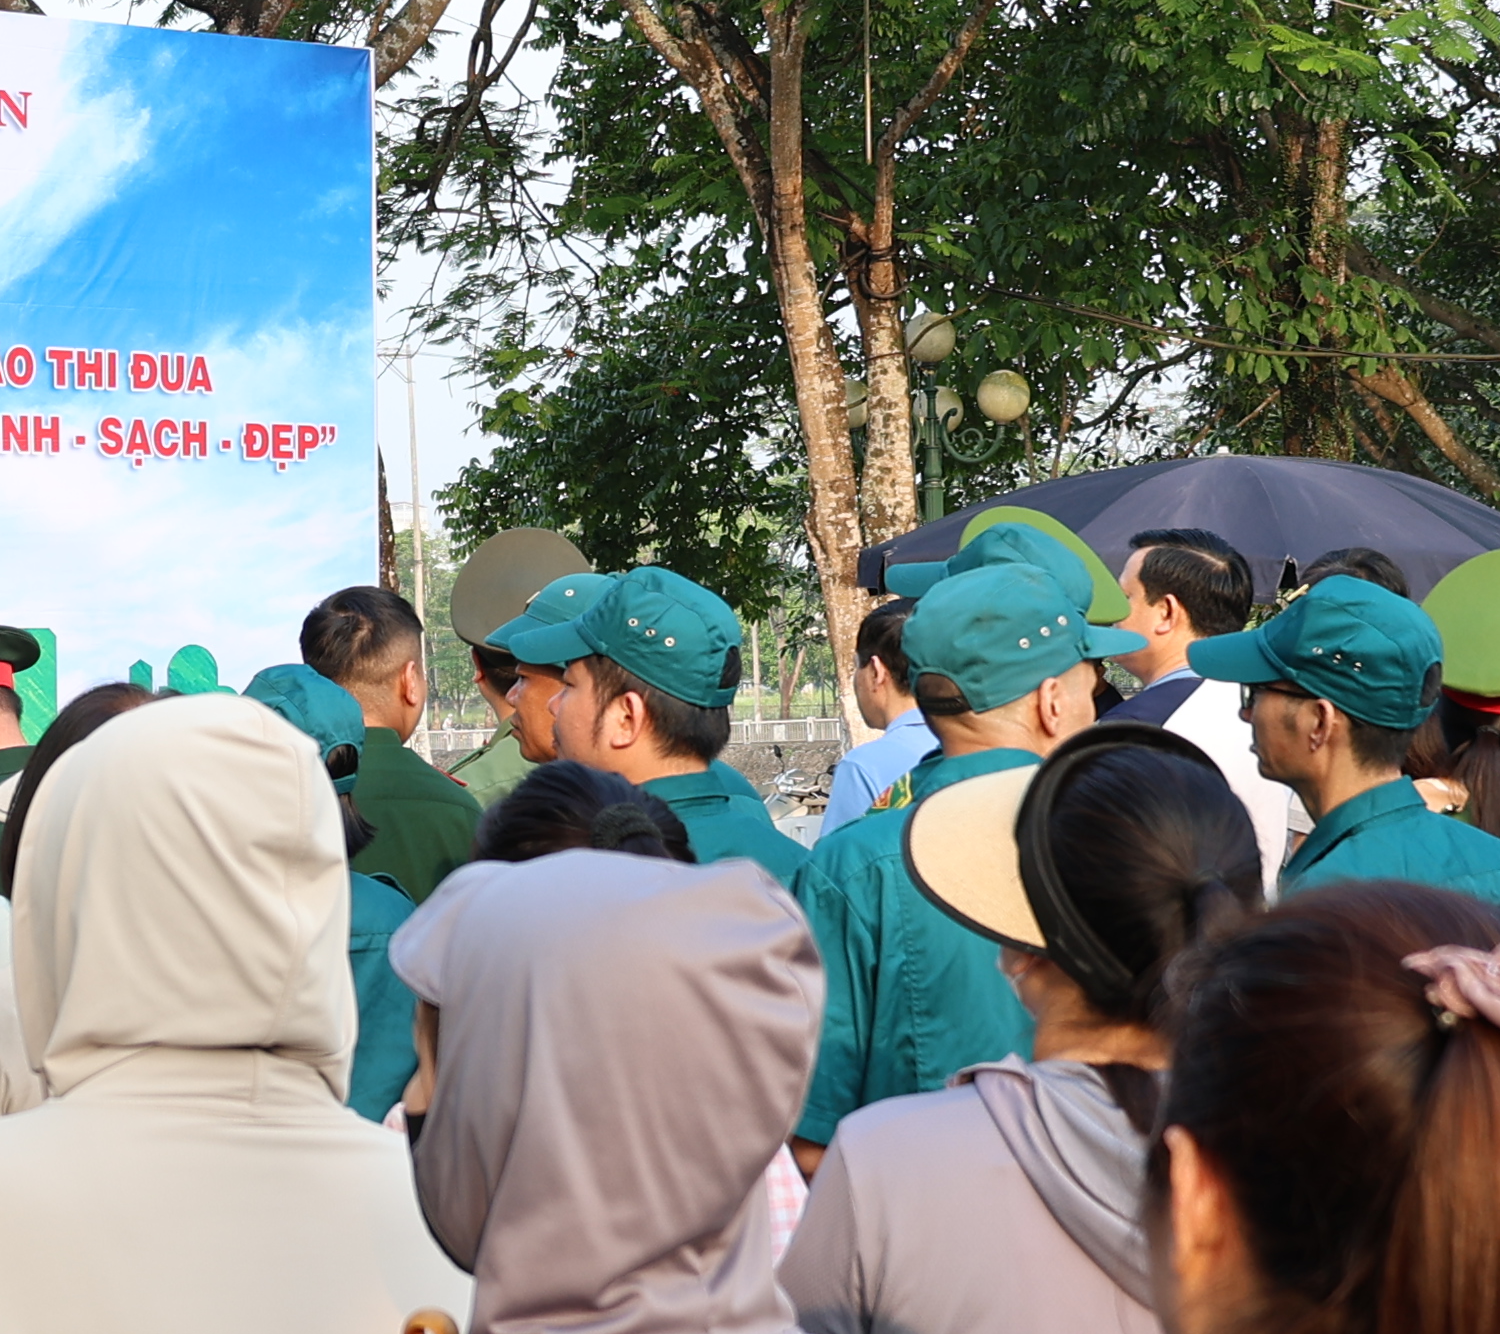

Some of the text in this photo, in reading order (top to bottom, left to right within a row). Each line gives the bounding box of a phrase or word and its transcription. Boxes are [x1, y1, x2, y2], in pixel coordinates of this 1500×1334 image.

[46, 347, 118, 390] THI
[129, 351, 215, 394] ĐUA
[99, 415, 209, 468] SẠCH
[241, 421, 338, 472] ĐẸP”
